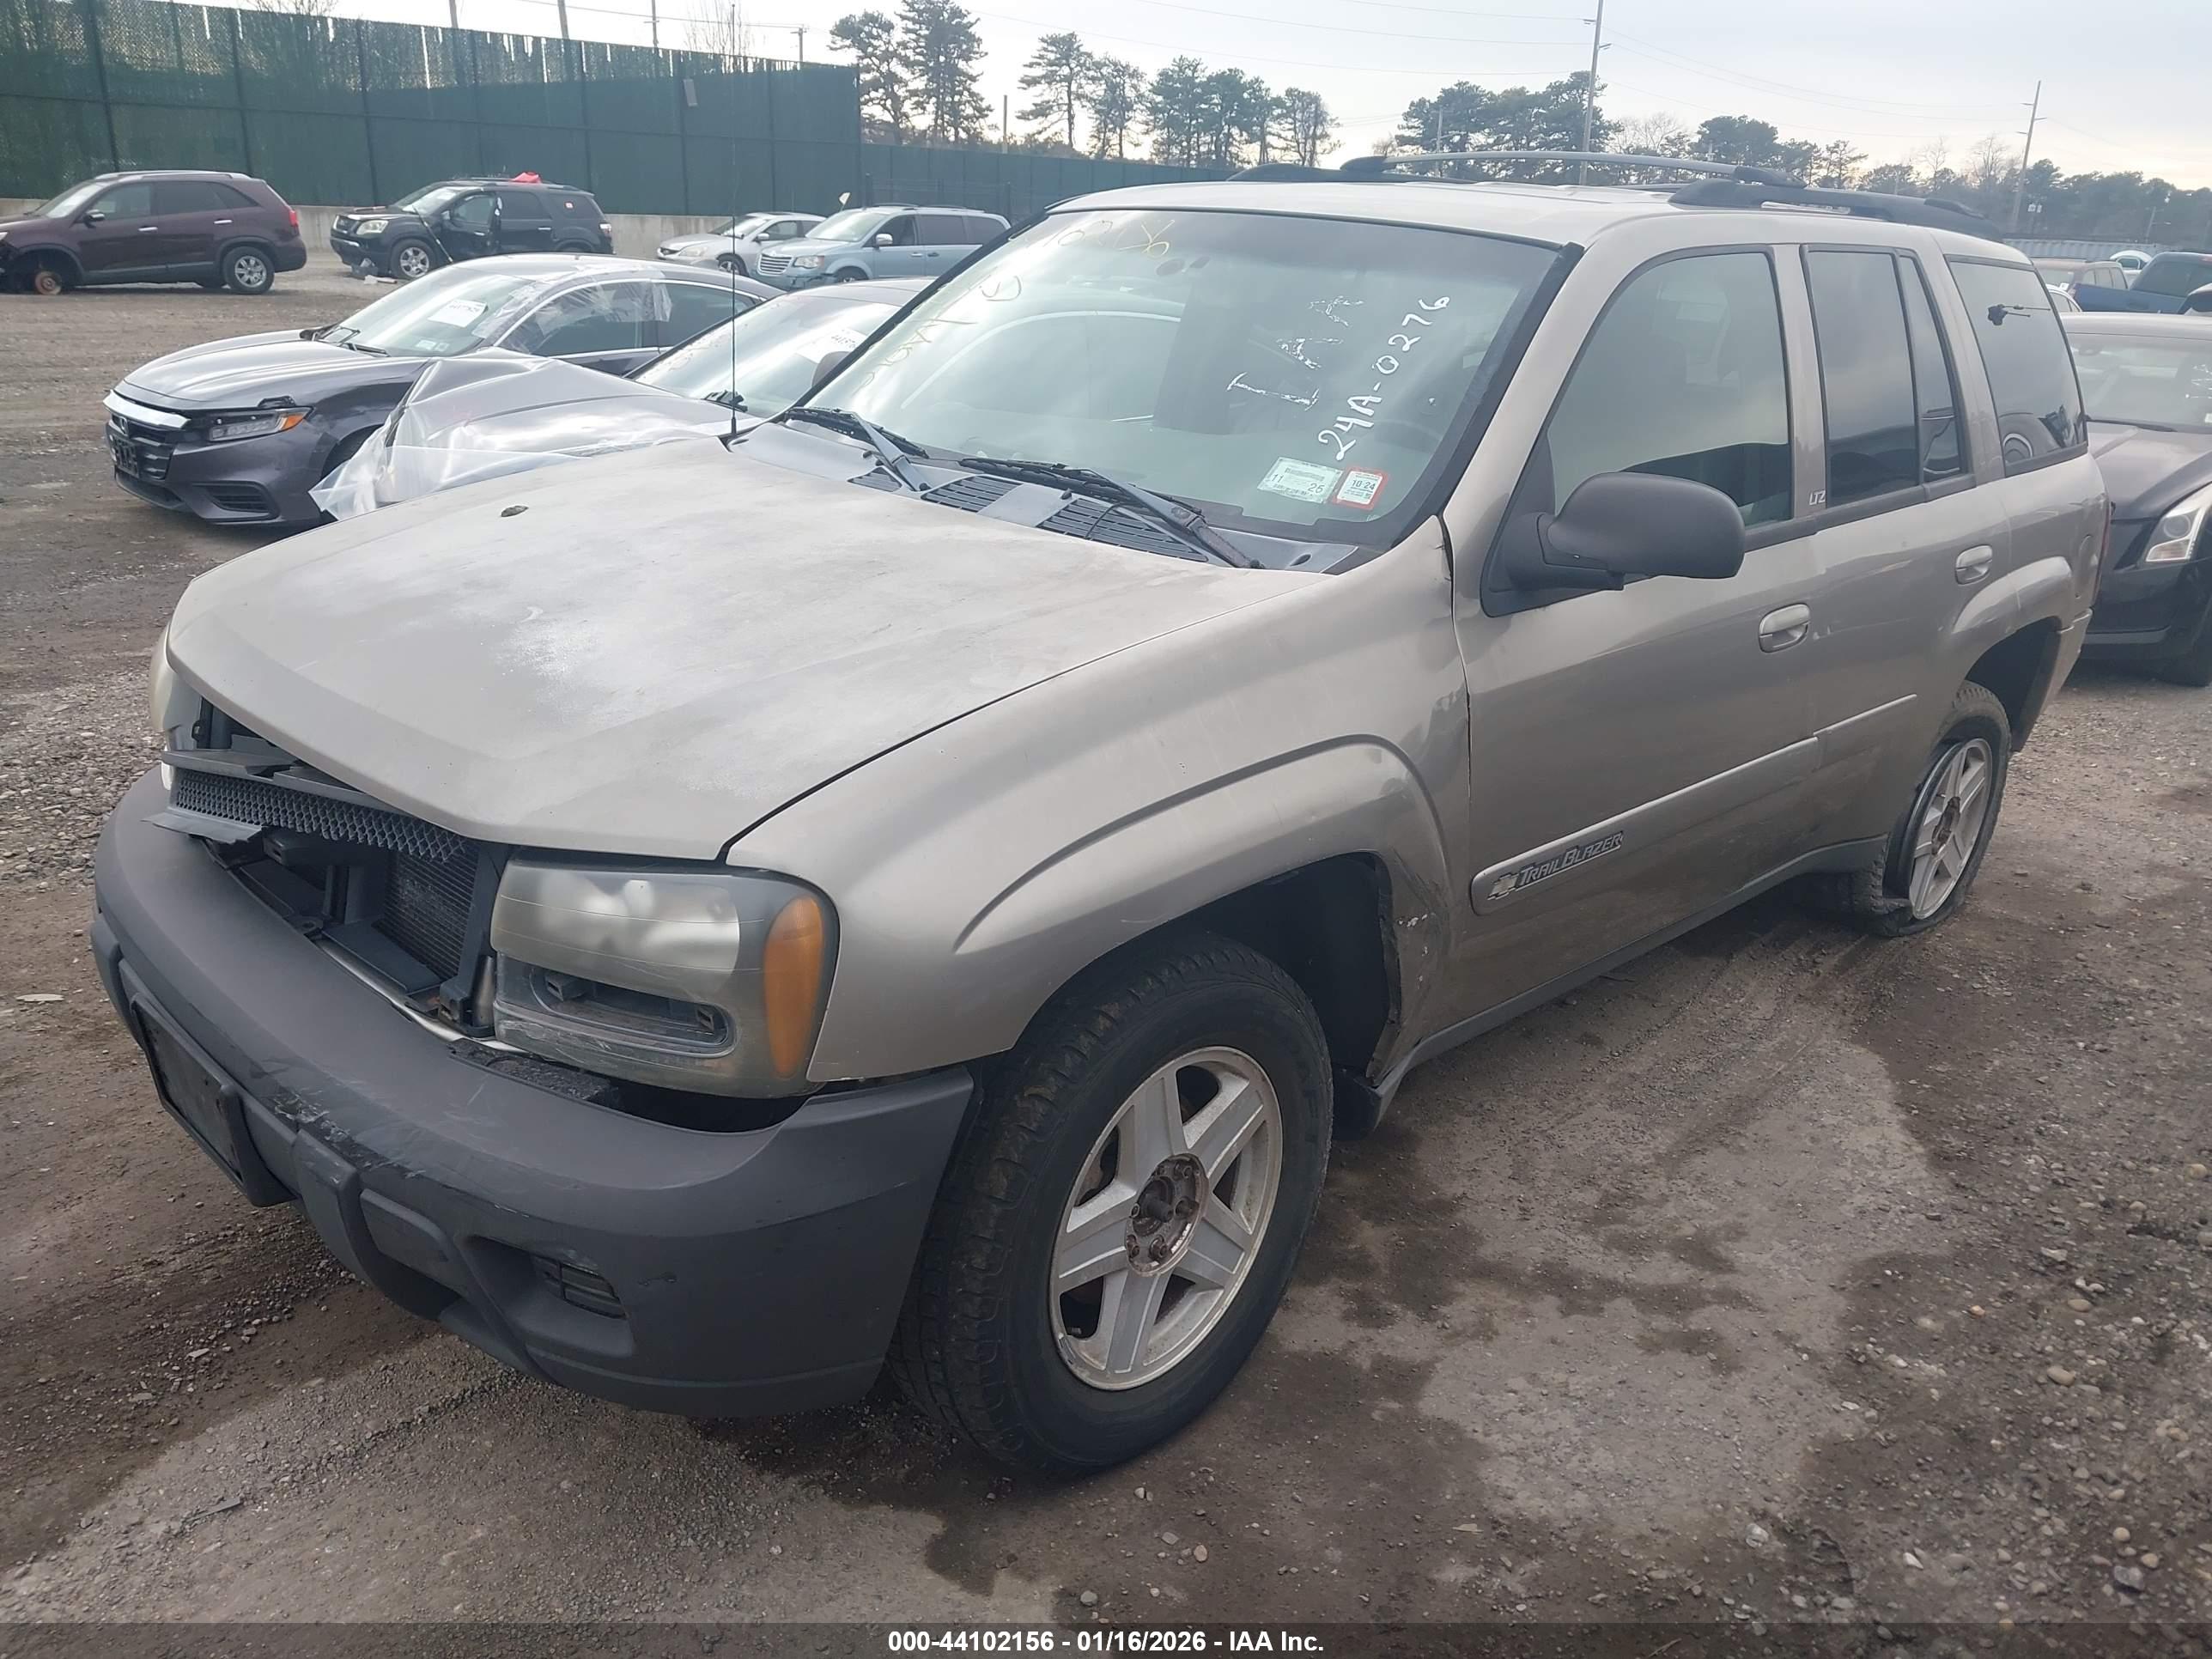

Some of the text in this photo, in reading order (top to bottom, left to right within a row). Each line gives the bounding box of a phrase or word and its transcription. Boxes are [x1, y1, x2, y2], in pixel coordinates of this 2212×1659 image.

[1317, 296, 1450, 461] 24A-0276
[1808, 489, 1826, 506] LTZ
[1519, 832, 1623, 886] TRAILBLAZER
